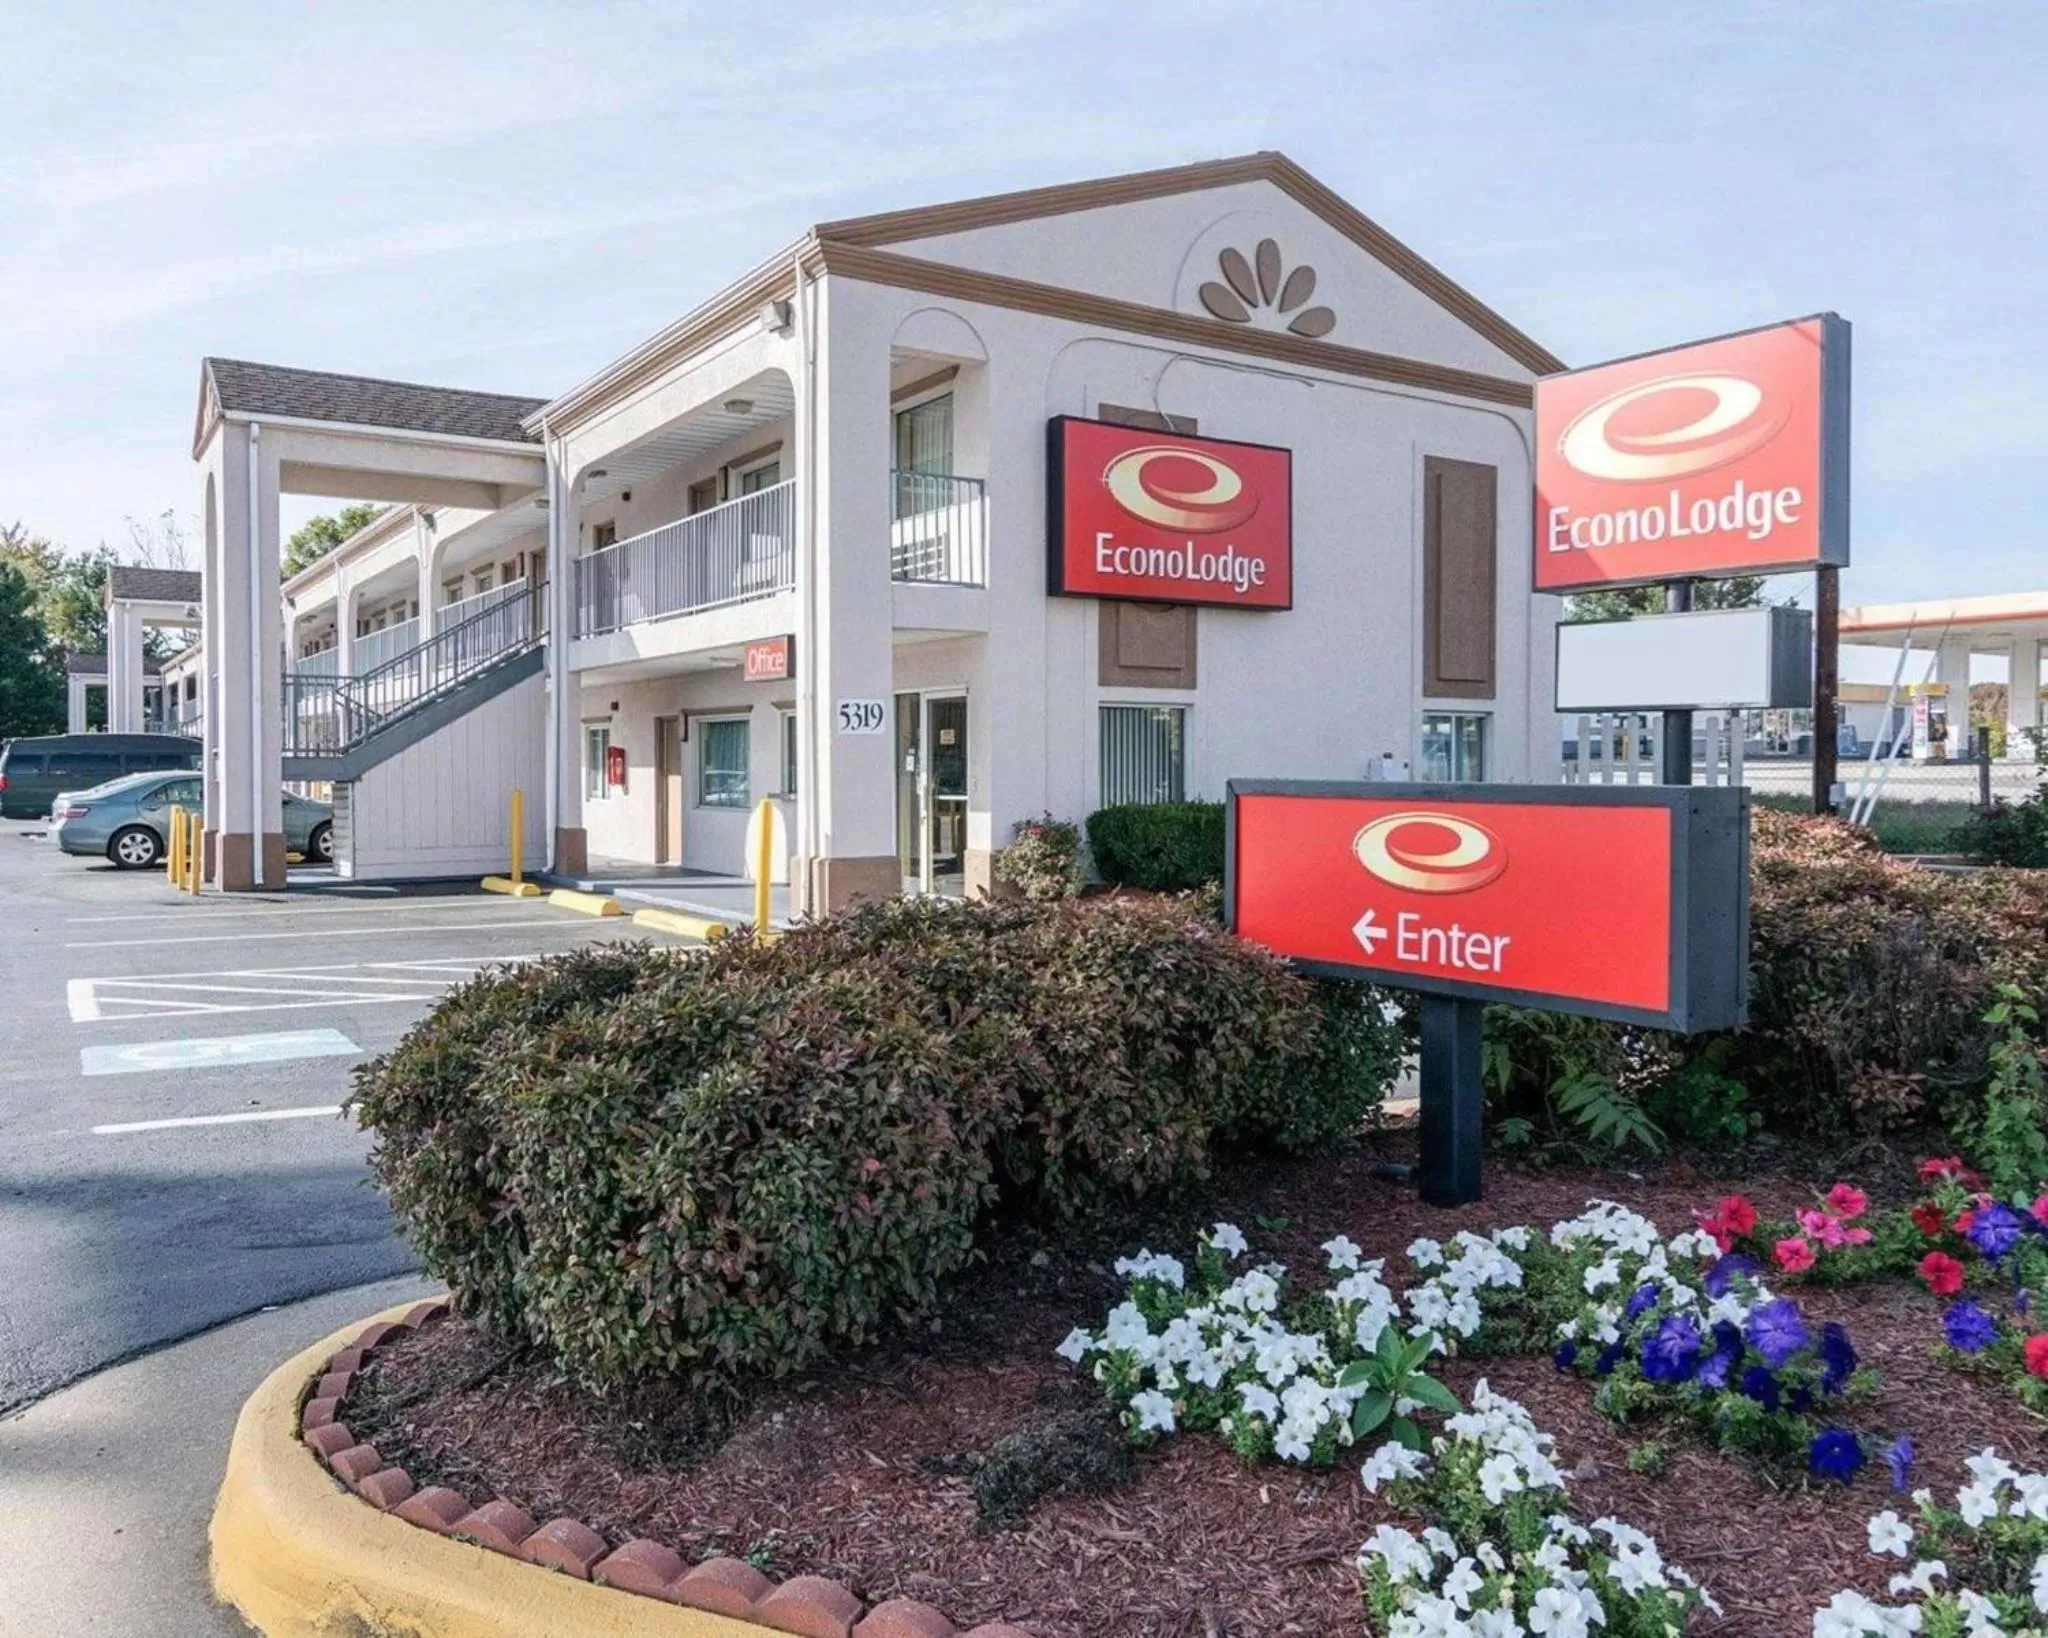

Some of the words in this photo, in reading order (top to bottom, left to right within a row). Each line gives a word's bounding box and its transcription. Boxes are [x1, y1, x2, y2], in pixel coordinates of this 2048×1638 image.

[1549, 479, 1802, 552] EconoLodge
[1095, 532, 1265, 593] EconoLodge
[747, 646, 785, 674] Office
[839, 702, 884, 731] 5319
[1396, 911, 1511, 973] Enter
